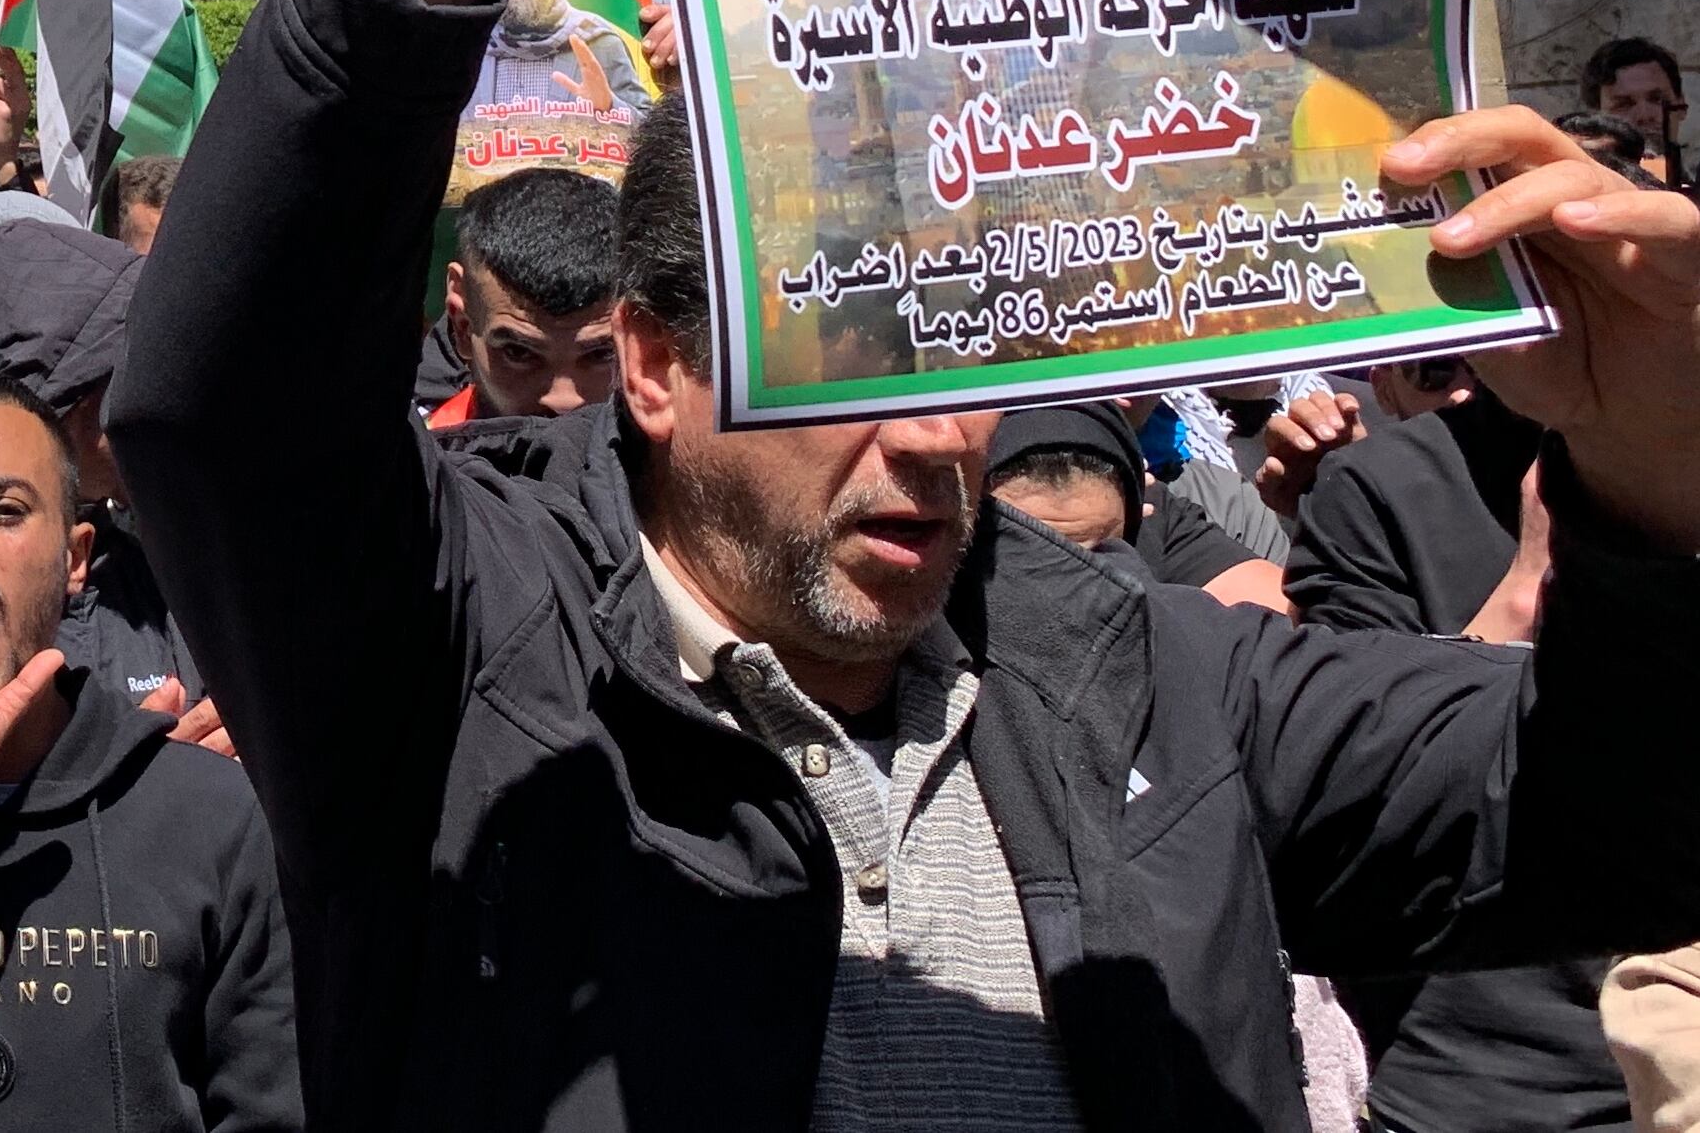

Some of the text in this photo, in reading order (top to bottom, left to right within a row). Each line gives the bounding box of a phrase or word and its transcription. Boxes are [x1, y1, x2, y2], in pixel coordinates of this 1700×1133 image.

[464, 127, 630, 167] ضر عدنان
[929, 72, 1260, 209] خضر عدنان
[986, 215, 1146, 283] 2/5/2023
[1149, 204, 1269, 274] بتاريخ
[911, 245, 988, 295] بعد
[1306, 261, 1366, 313] عن
[994, 287, 1050, 340] 86
[1049, 274, 1173, 346] استمر
[1180, 259, 1301, 337] الطعام
[127, 673, 168, 693] Reeb
[16, 926, 160, 969] PEPETO
